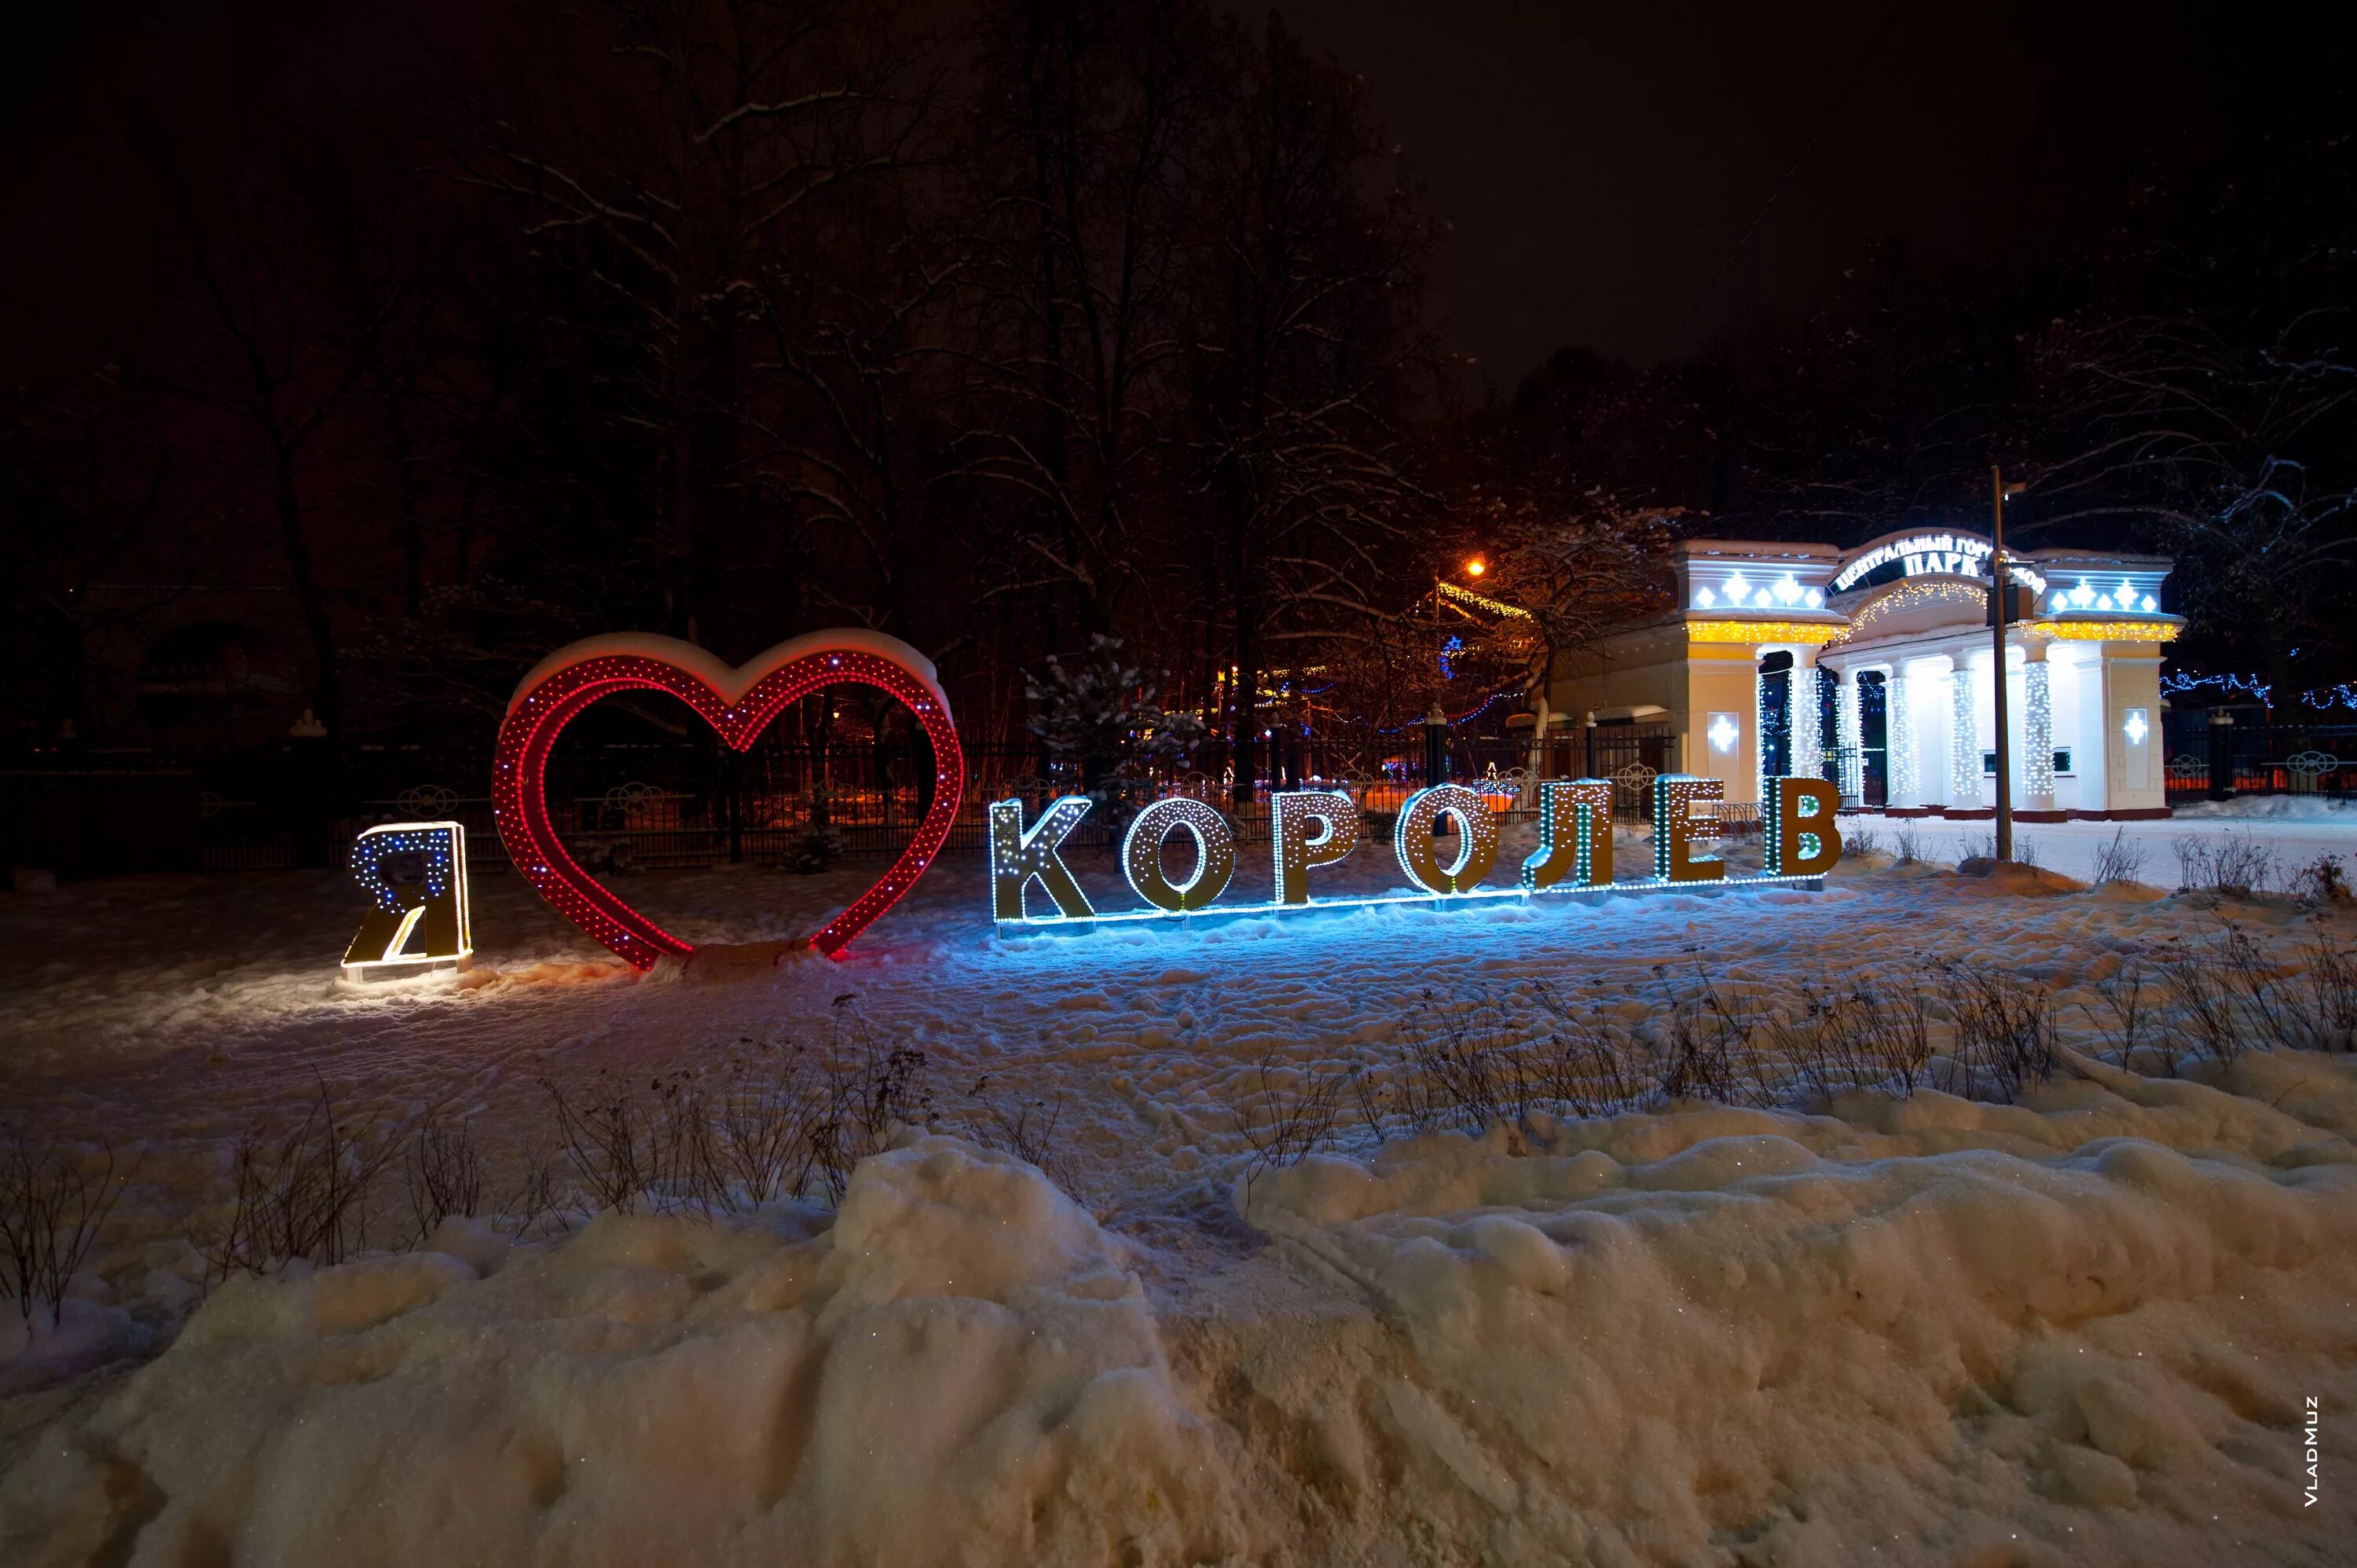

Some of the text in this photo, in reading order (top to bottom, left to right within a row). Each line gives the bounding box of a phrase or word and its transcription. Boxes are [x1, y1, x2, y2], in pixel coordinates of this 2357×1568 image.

[1836, 534, 2047, 595] ЦЕНТРАЛЬНЫЙ ГОРКОЙ
[1903, 551, 1980, 577] ПАРК
[341, 775, 1842, 969] Я КОРОЛЕВ
